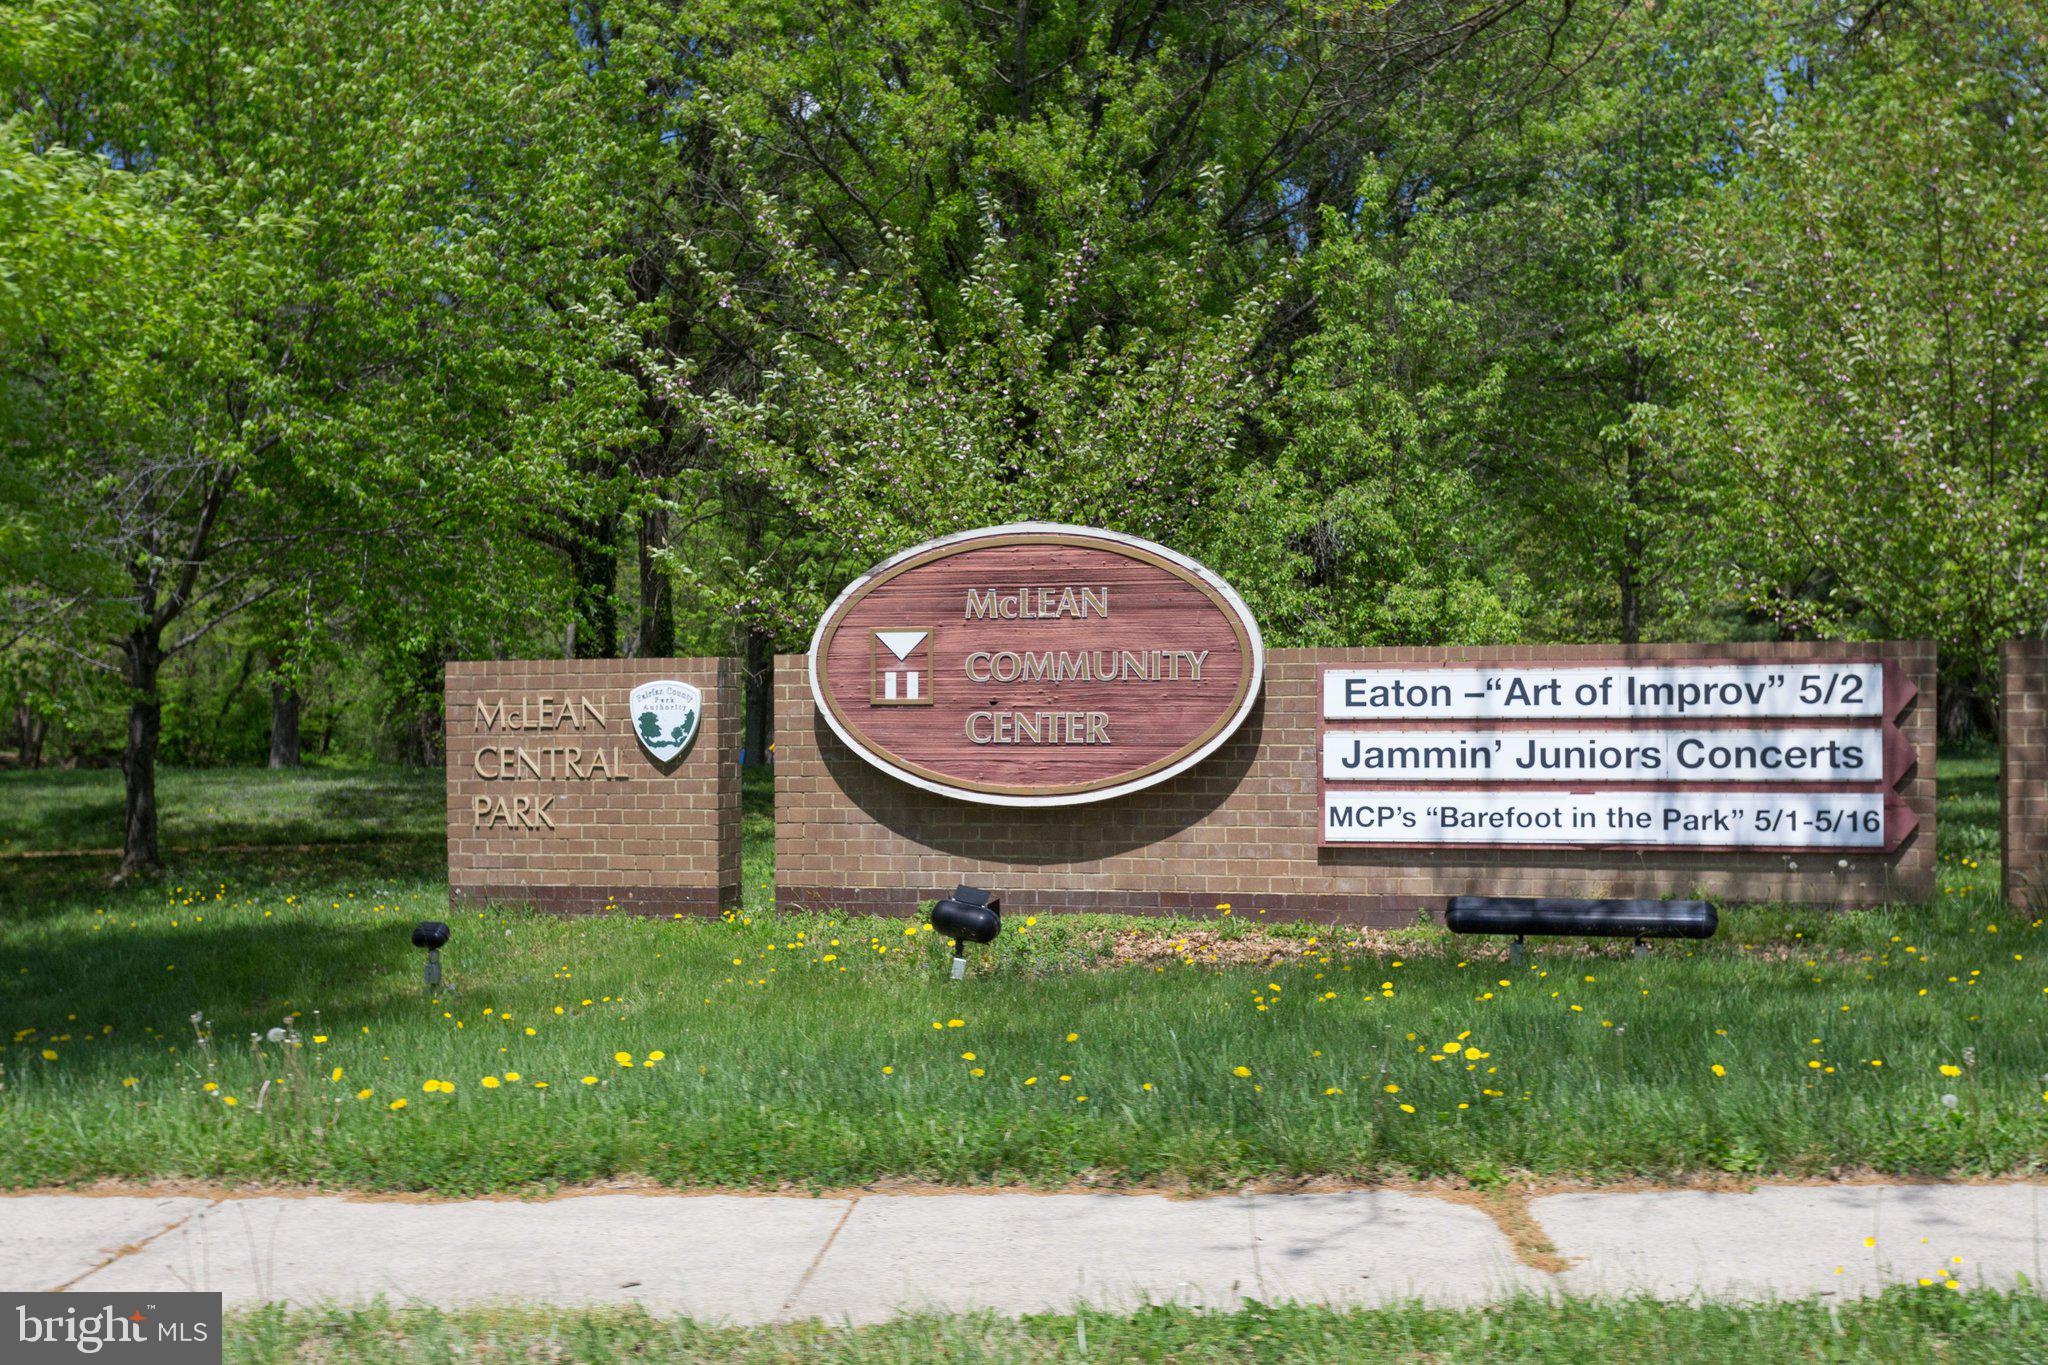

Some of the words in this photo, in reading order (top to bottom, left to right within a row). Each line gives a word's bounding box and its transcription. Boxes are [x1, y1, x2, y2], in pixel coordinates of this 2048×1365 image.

[964, 586, 1109, 620] McLEAN
[964, 650, 1209, 683] COMMUNITY
[1345, 678, 1452, 708] Eaton
[1574, 676, 1613, 706] of
[1627, 674, 1785, 713] Improv”
[1799, 673, 1864, 705] 5/2
[474, 695, 607, 732] McLEAN
[964, 711, 1111, 745] CENTER
[474, 746, 630, 782] CENTRAL
[1341, 739, 1502, 769] Jammin’
[1515, 739, 1662, 769] Juniors
[1676, 738, 1864, 769] Concerts
[474, 795, 556, 831] PARK
[1329, 806, 1417, 828] MCP’s
[1426, 806, 1563, 828] “Barefoot
[1572, 807, 1596, 828] in
[1606, 807, 1652, 829] the
[1662, 808, 1744, 832] Park”
[1754, 809, 1881, 834] 5/1-5/16
